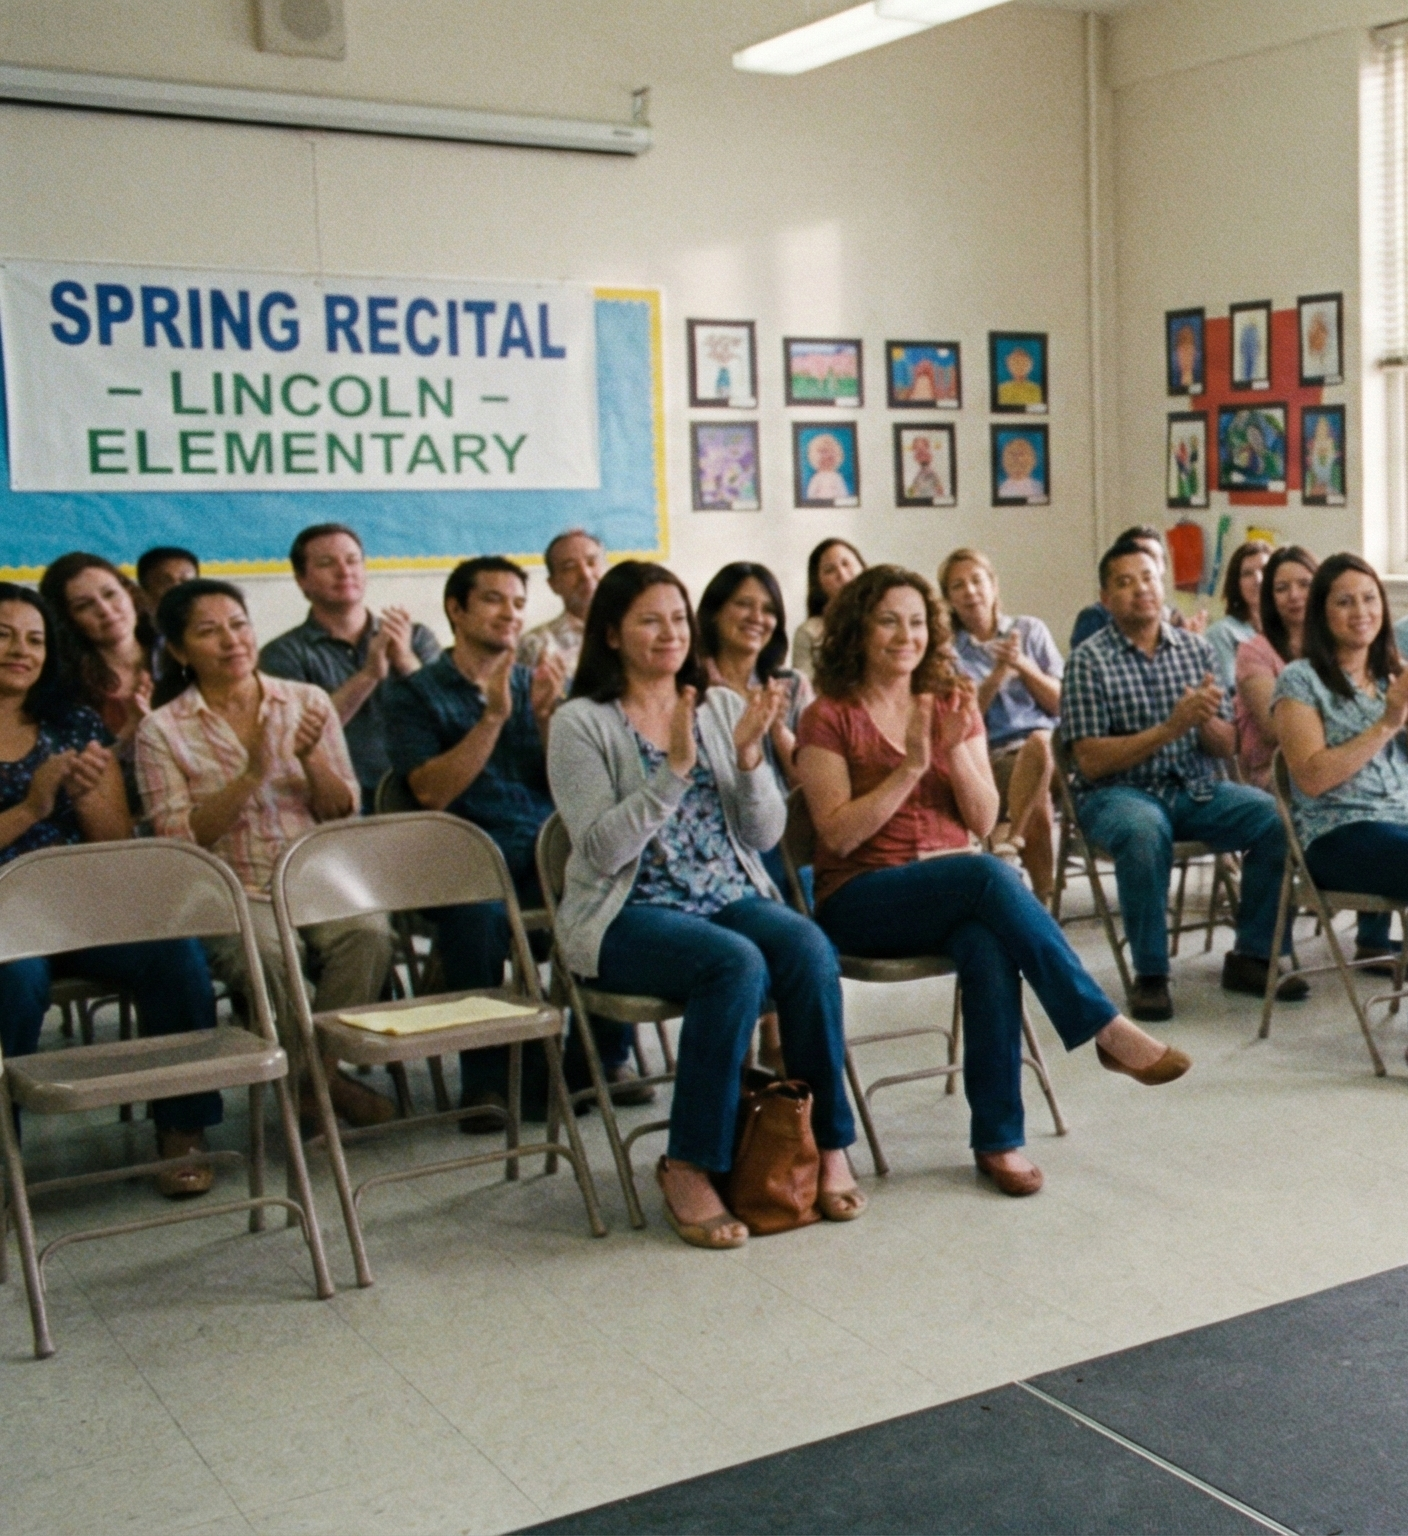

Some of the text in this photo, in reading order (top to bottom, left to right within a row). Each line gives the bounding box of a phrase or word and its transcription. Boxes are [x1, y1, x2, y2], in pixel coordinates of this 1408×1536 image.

[49, 279, 566, 359] SPRING RECITAL
[170, 370, 453, 418] LINCOLN
[87, 428, 528, 475] ELEMENTARY
